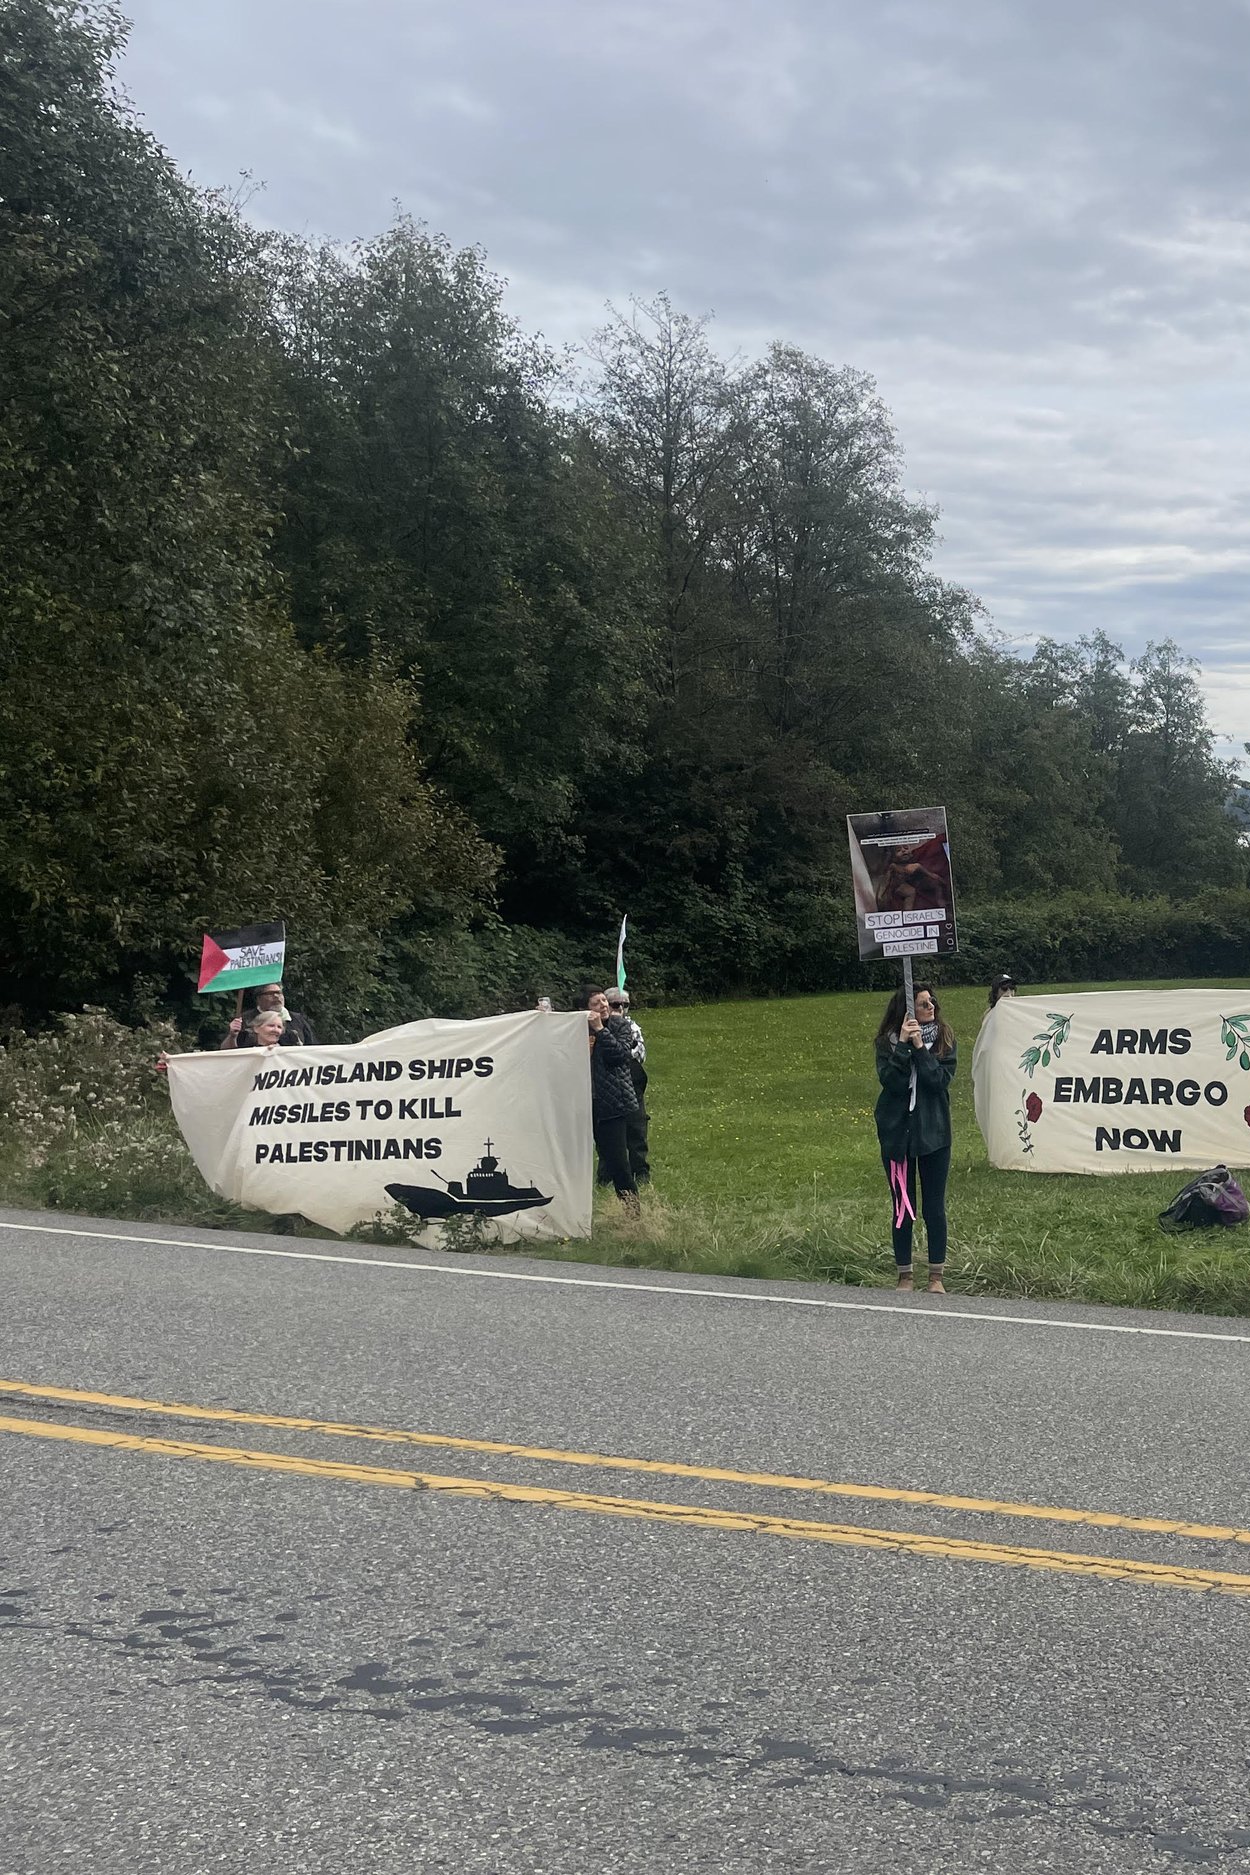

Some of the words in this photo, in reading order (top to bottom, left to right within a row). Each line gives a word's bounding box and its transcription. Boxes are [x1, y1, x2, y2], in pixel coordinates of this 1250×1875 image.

[867, 913, 900, 927] STOP
[904, 910, 944, 922] ISRAEL'S
[875, 928, 923, 940] GENOCIDE
[928, 927, 938, 936] IN
[885, 941, 935, 953] PALESTINE
[239, 944, 266, 959] SAVE
[1090, 1028, 1192, 1055] ARMS
[316, 1060, 403, 1085] ISLAND
[408, 1056, 494, 1080] SHIPS
[1053, 1076, 1228, 1107] EMBARGO
[249, 1101, 350, 1126] MISSILES
[355, 1099, 393, 1121] TO
[399, 1097, 461, 1120] KILL
[255, 1137, 442, 1164] PALESTINIANS
[1095, 1126, 1182, 1153] NOW
